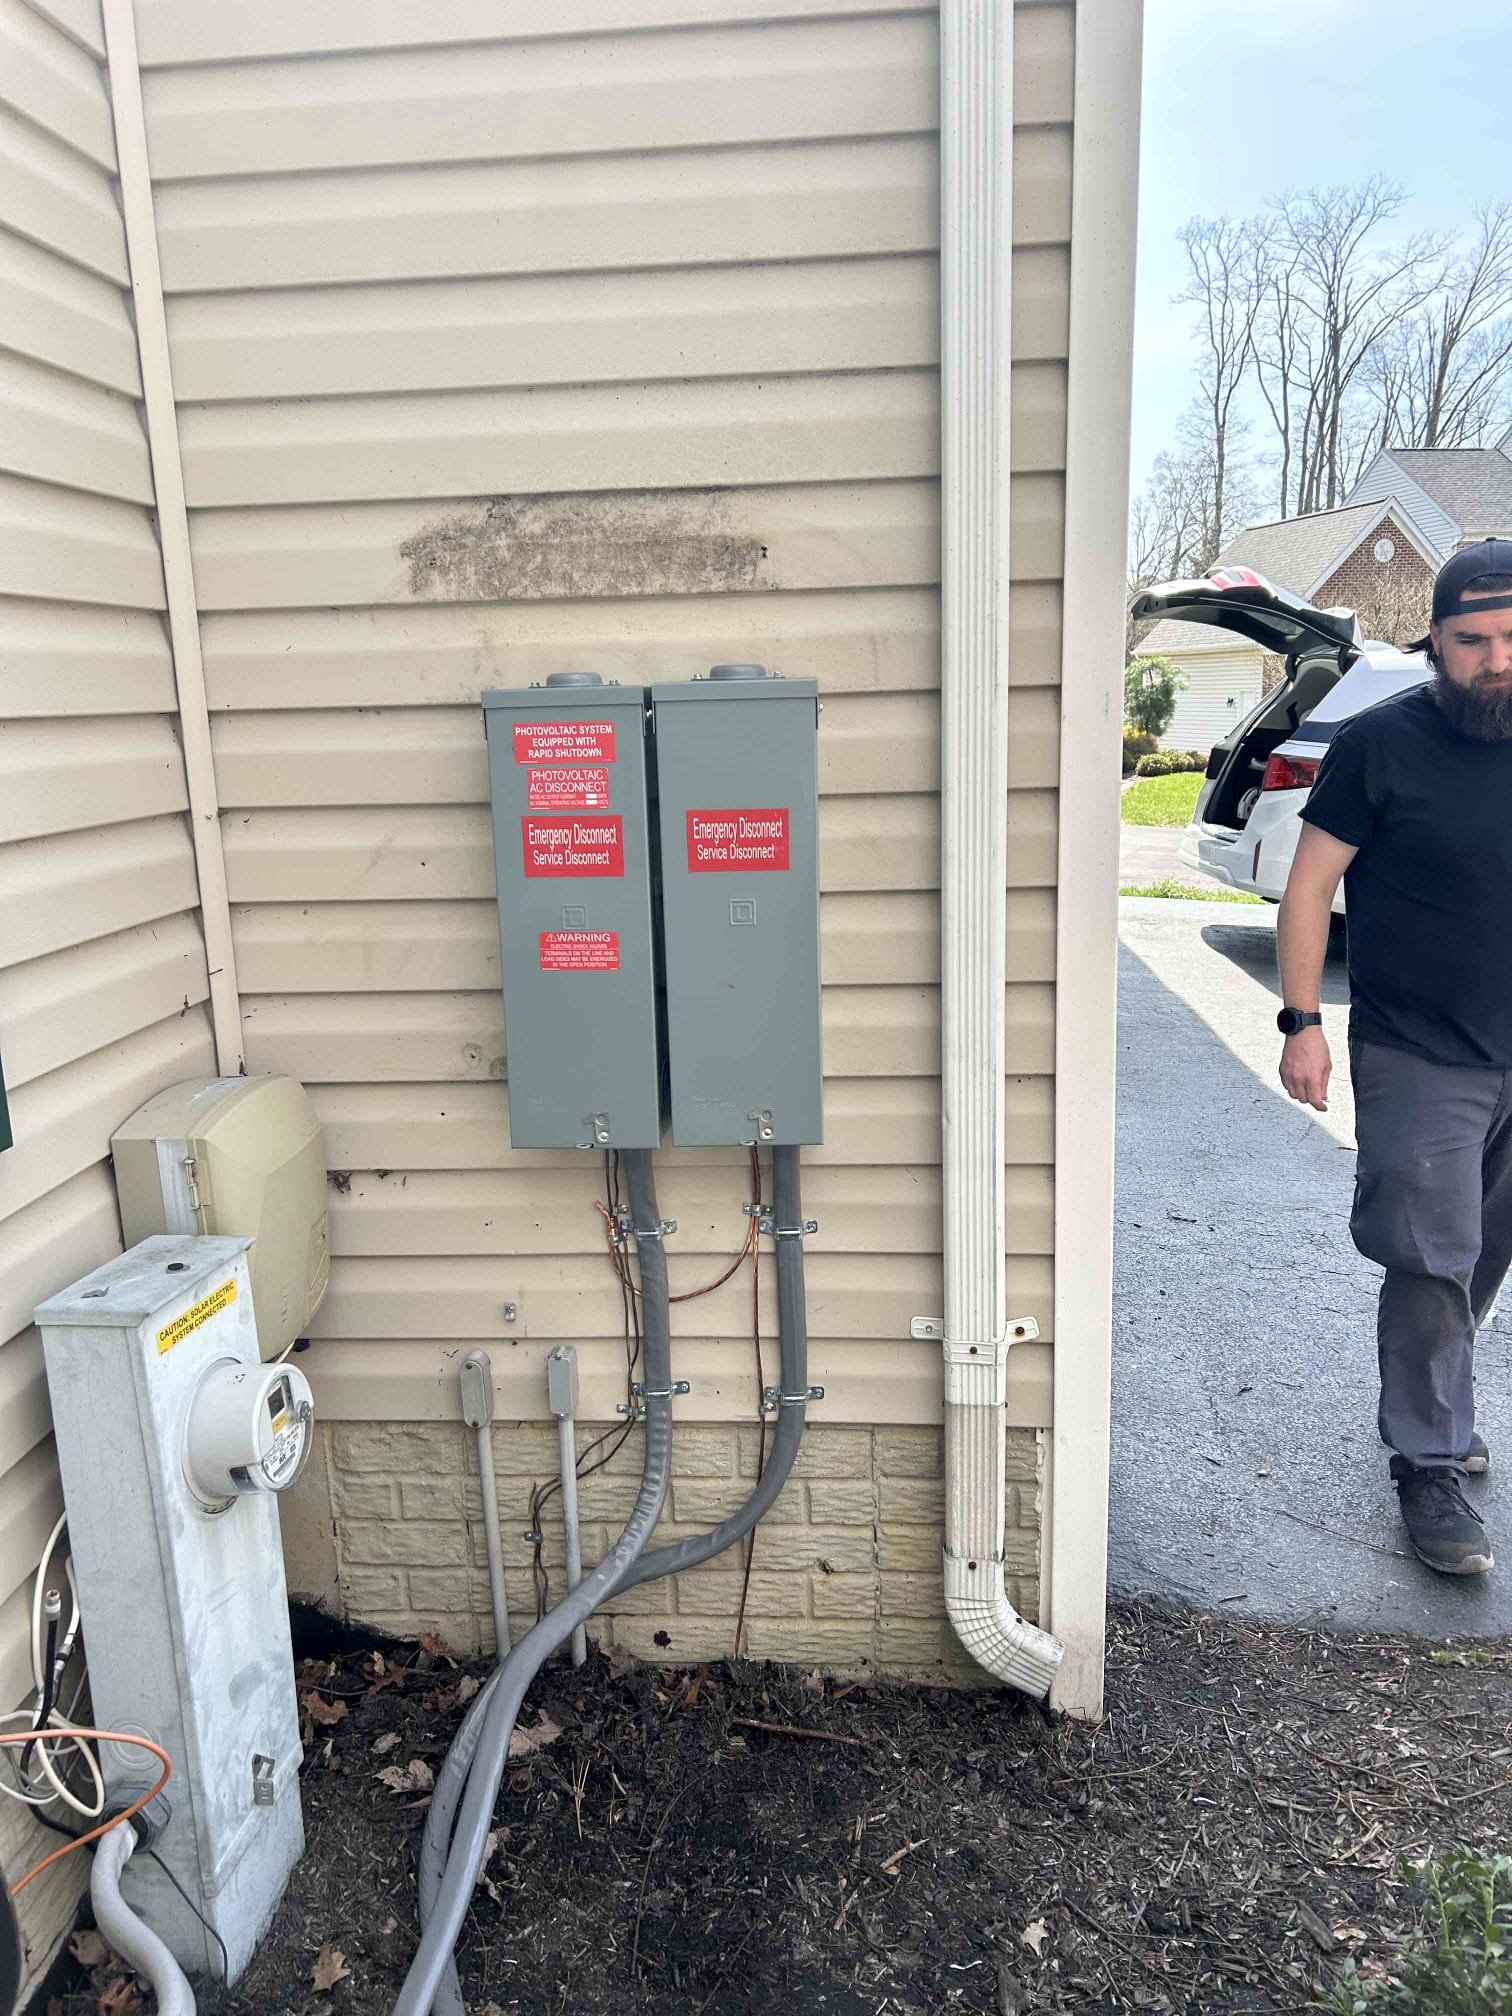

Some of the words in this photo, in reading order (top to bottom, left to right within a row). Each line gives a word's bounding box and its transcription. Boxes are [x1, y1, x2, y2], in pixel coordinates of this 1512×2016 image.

[515, 726, 577, 736] PHOTOVOLTAIC
[579, 725, 612, 734] SYSTEM
[532, 737, 574, 746] EQUIPPED
[575, 736, 596, 746] WITH
[528, 749, 553, 758] RAPID
[555, 748, 602, 758] SHUTDOWN
[531, 770, 604, 781] PHOTOVOLTAIC
[530, 783, 543, 793] AC
[545, 781, 607, 792] DISCONNECT
[528, 824, 572, 850] Emergency
[574, 823, 617, 845] Disconnect
[693, 818, 737, 845] Emergency
[739, 817, 783, 838] Disconnect
[533, 850, 563, 865] Service
[565, 850, 610, 865] Disconnect
[697, 844, 728, 860] Service
[730, 843, 774, 860] Disconnect
[557, 934, 610, 942] WARNING
[160, 1314, 190, 1341] CAUTION:
[191, 1300, 209, 1319] SOLAR
[209, 1281, 234, 1305] ELECTRIC
[172, 1322, 194, 1345] SYSTEM
[195, 1299, 227, 1327] CONNECTED
